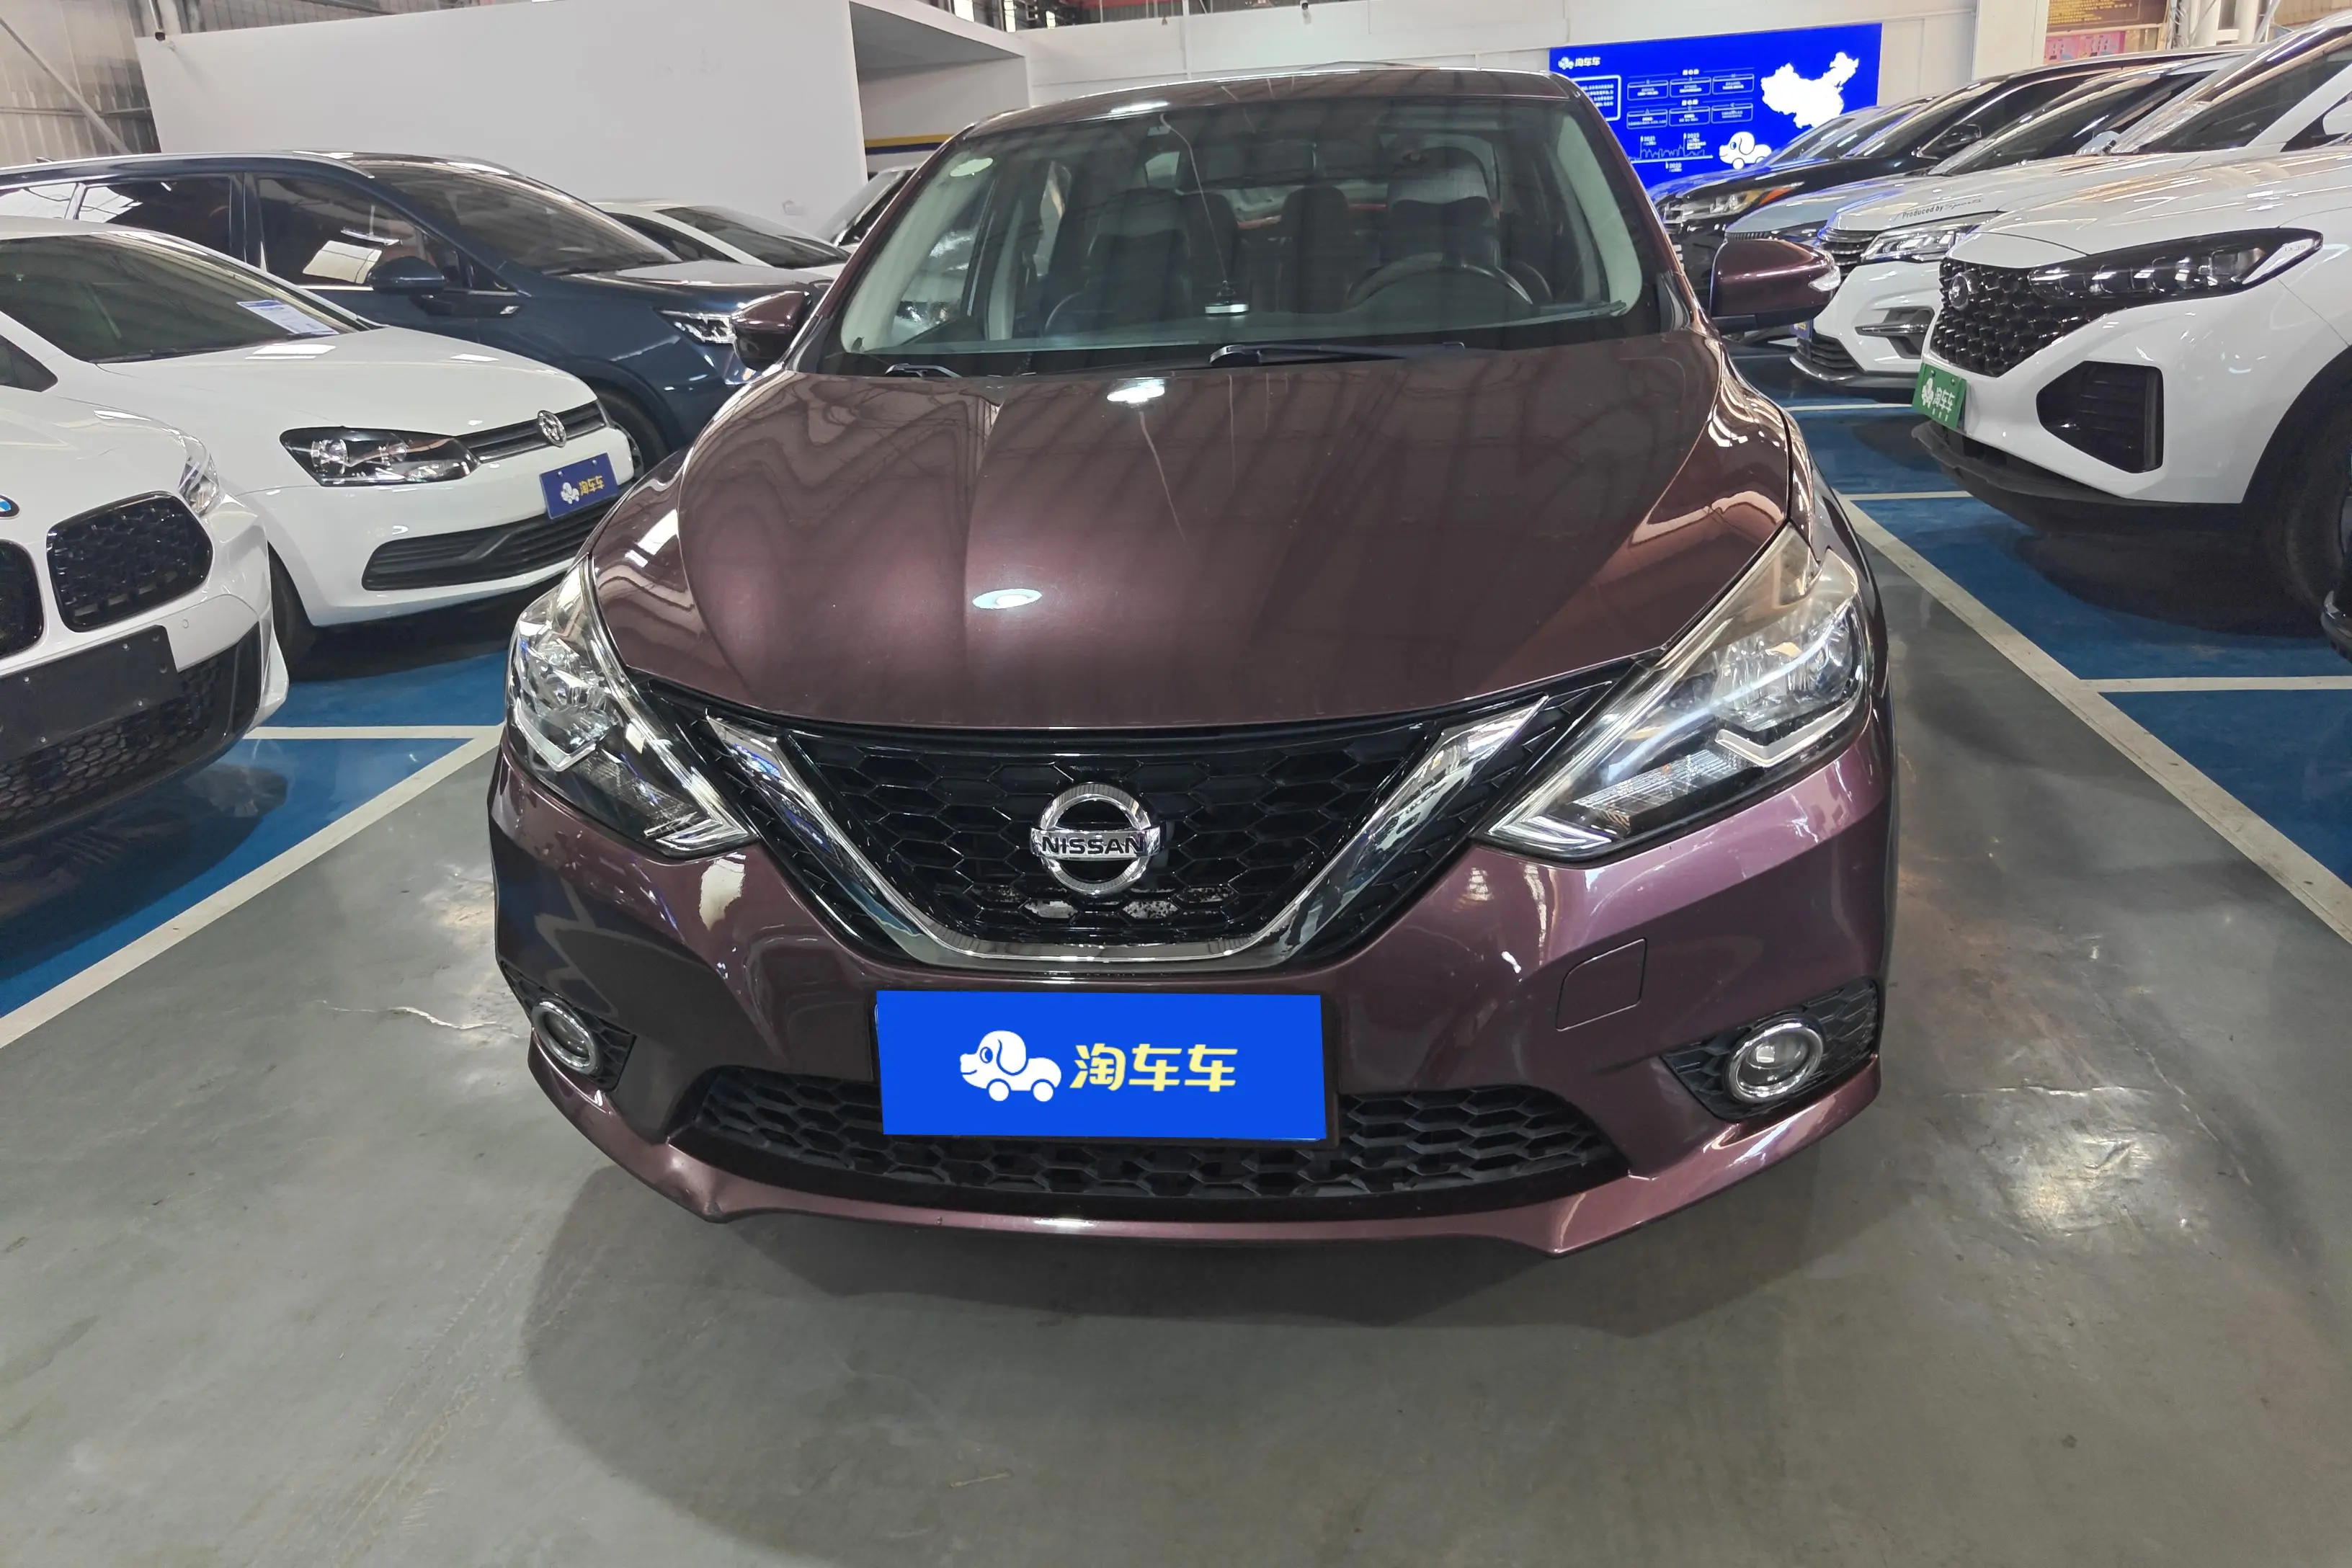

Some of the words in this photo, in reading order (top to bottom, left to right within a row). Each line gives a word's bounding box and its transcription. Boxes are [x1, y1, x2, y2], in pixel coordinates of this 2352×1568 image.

[1902, 205, 1934, 219] Produced
[1933, 386, 1956, 414] 淘车车
[579, 475, 605, 496] 淘车车
[1042, 836, 1146, 855] NISSAN
